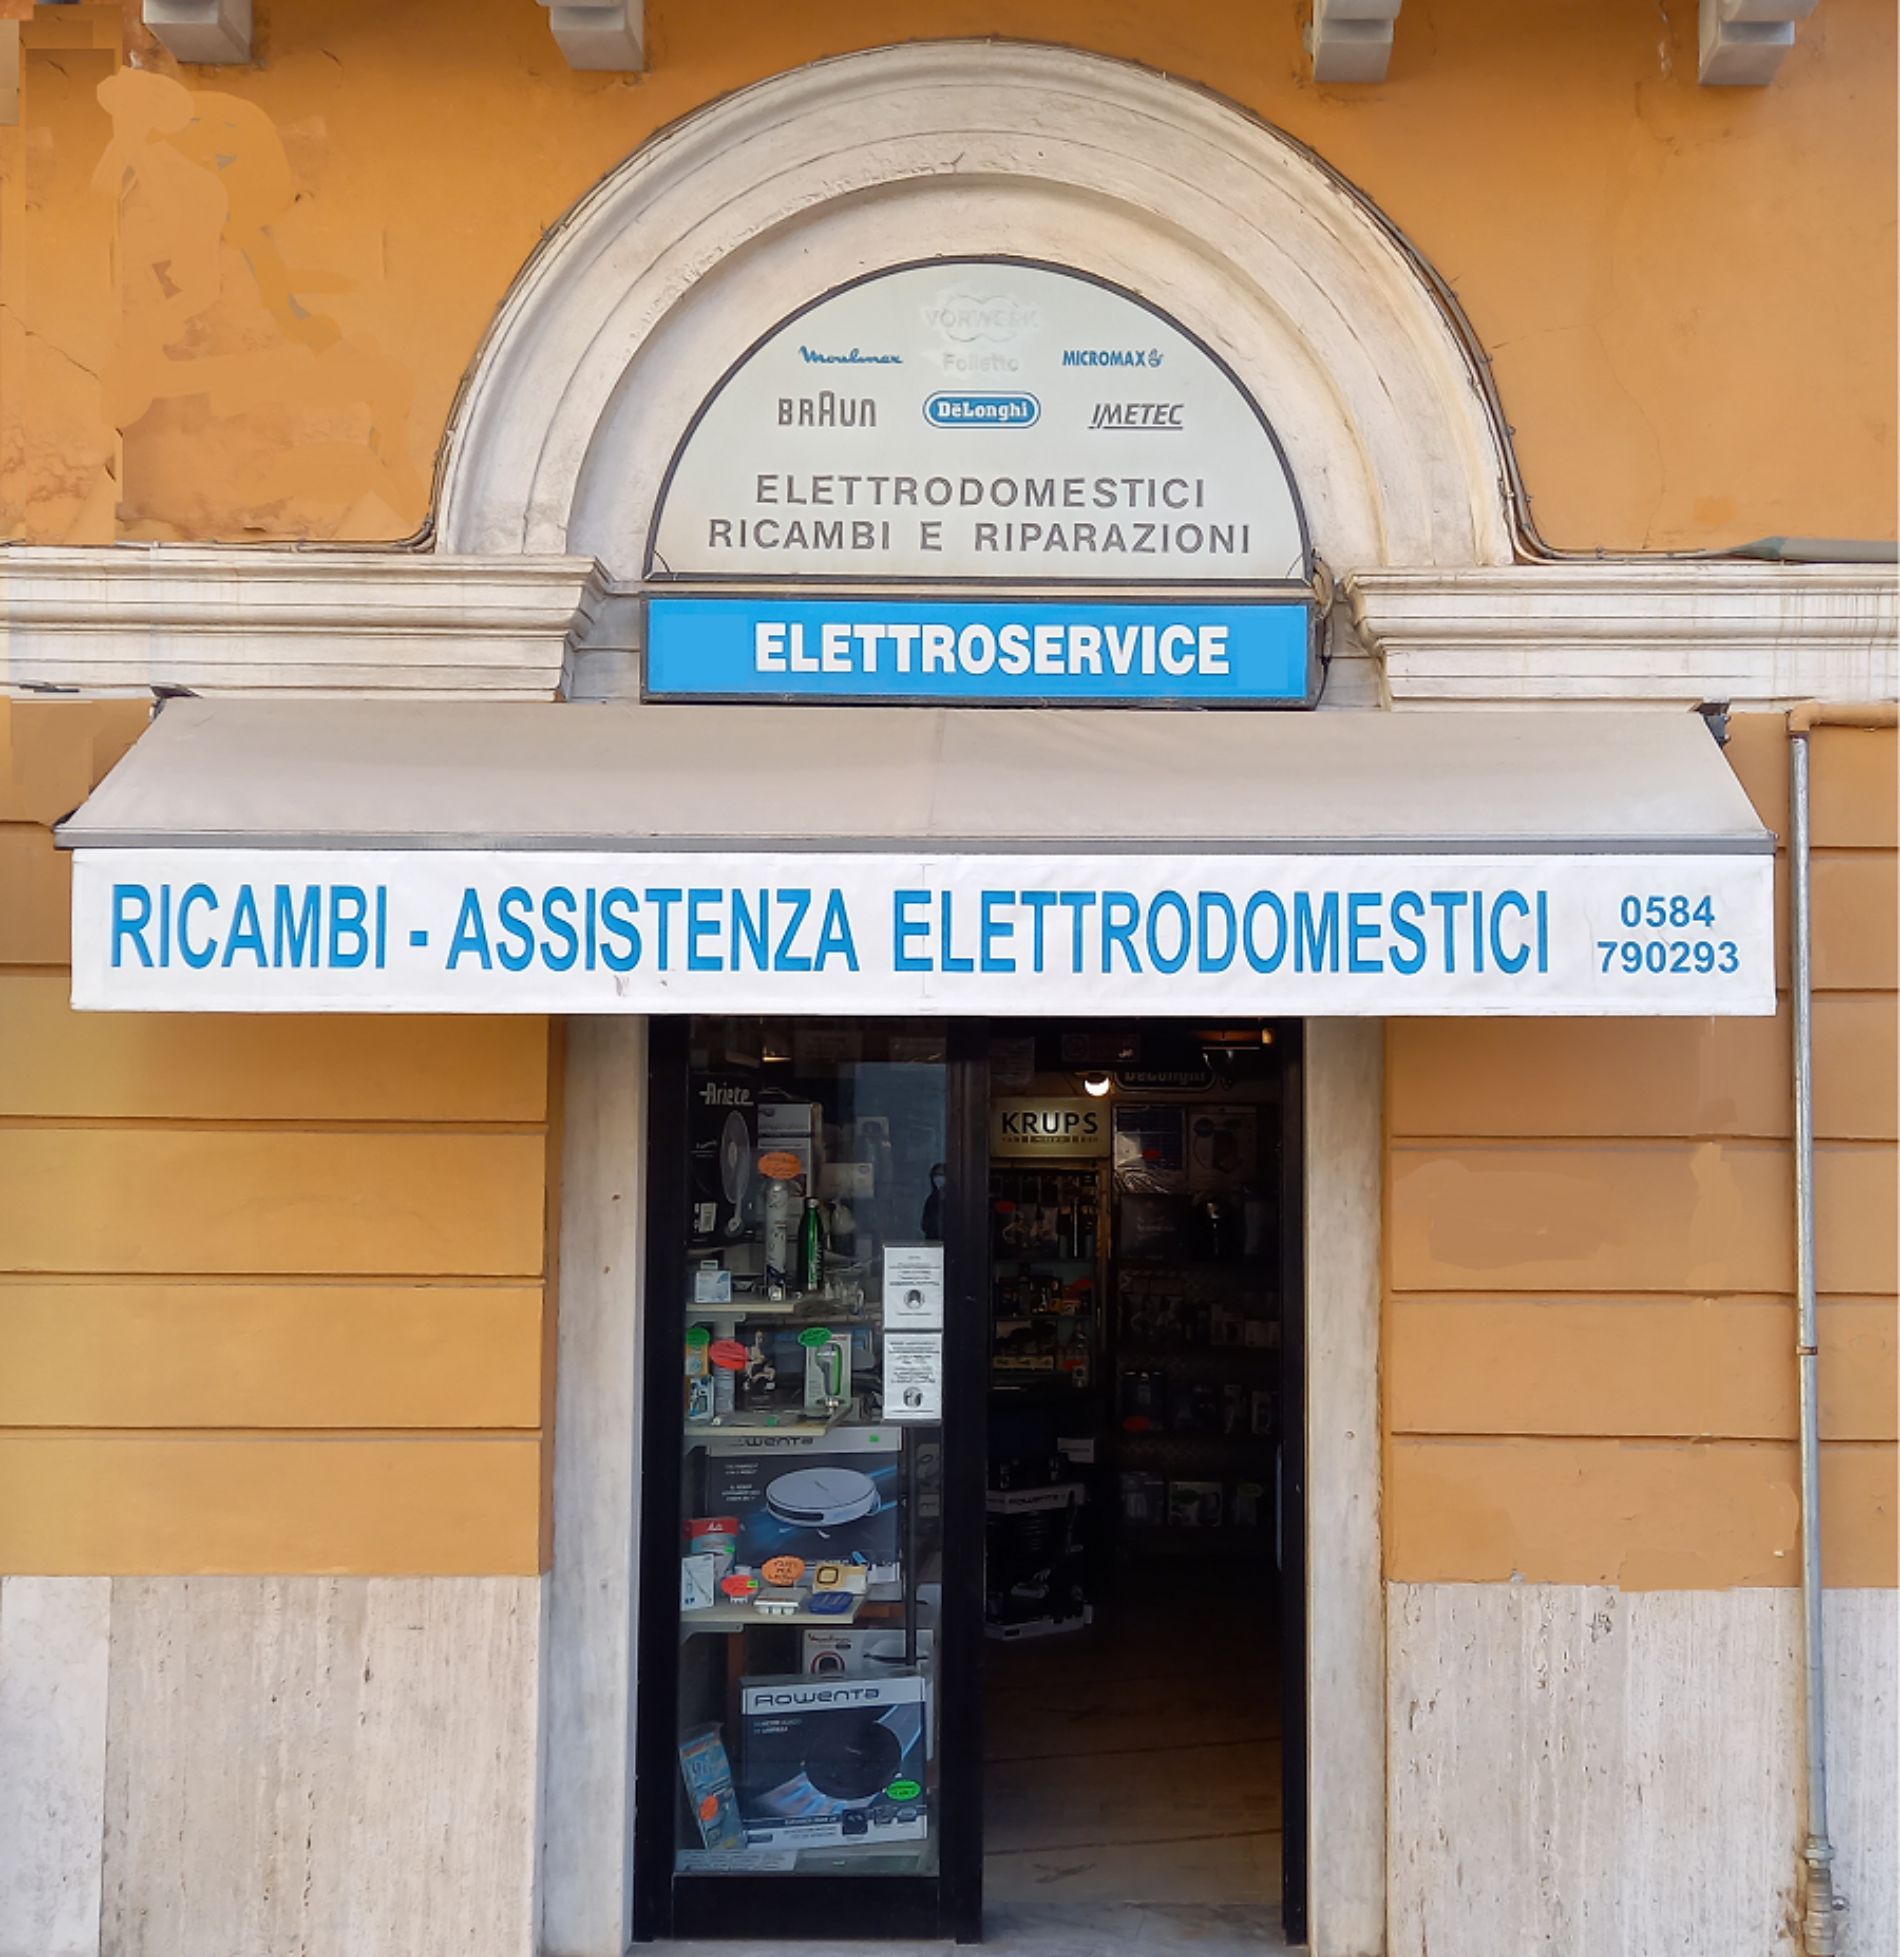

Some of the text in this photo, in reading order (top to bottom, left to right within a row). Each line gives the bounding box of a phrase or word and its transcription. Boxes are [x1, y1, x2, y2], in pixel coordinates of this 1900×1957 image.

[1062, 350, 1146, 367] MICROMAX
[779, 390, 876, 427] BRAUN
[1091, 403, 1185, 428] IMETEC
[756, 474, 1204, 509] ELETTRODOMESTICI
[708, 518, 1250, 554] RICAMBI E RIPARAZIONI
[756, 622, 1230, 676] ELETTROSERVICE
[1620, 895, 1717, 929] 0584
[112, 884, 388, 970] RICAMBI
[447, 885, 860, 973] ASSISTENZA
[894, 889, 1549, 976] ELETTRODOMESTICI
[1598, 940, 1741, 975] 790293
[698, 1080, 755, 1106] Ariete
[1001, 1111, 1099, 1135] KRUPS
